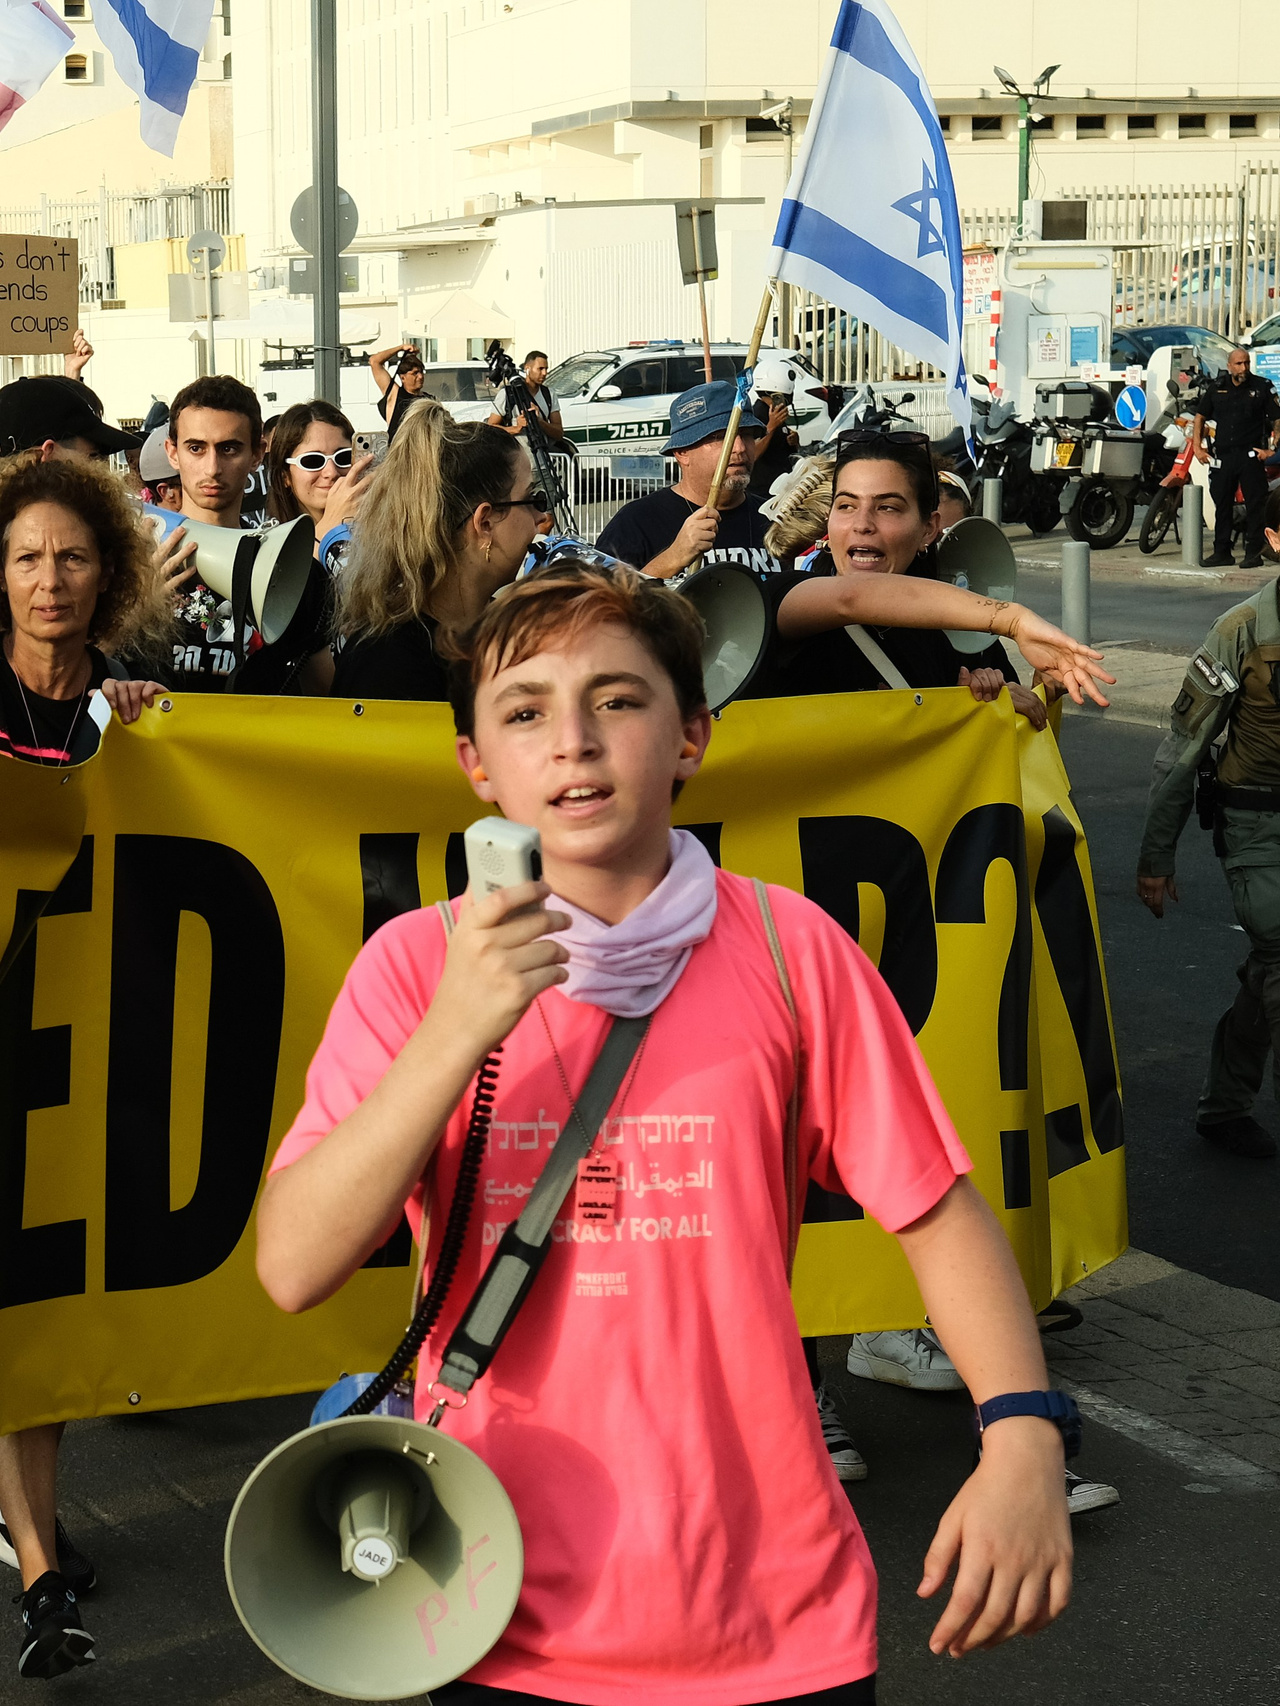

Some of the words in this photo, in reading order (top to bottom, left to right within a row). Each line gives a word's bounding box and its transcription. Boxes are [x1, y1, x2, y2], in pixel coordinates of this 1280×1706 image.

[16, 239, 70, 271] don't
[11, 316, 69, 343] coups
[607, 422, 664, 439] הגבול
[486, 1108, 560, 1158] לכולן
[599, 1114, 716, 1152] דמוקרט
[616, 1159, 714, 1199] الديمقرا
[482, 1218, 626, 1246] DECRACY
[630, 1216, 673, 1243] FOR
[676, 1213, 713, 1239] ALL
[358, 1549, 389, 1567] JADE
